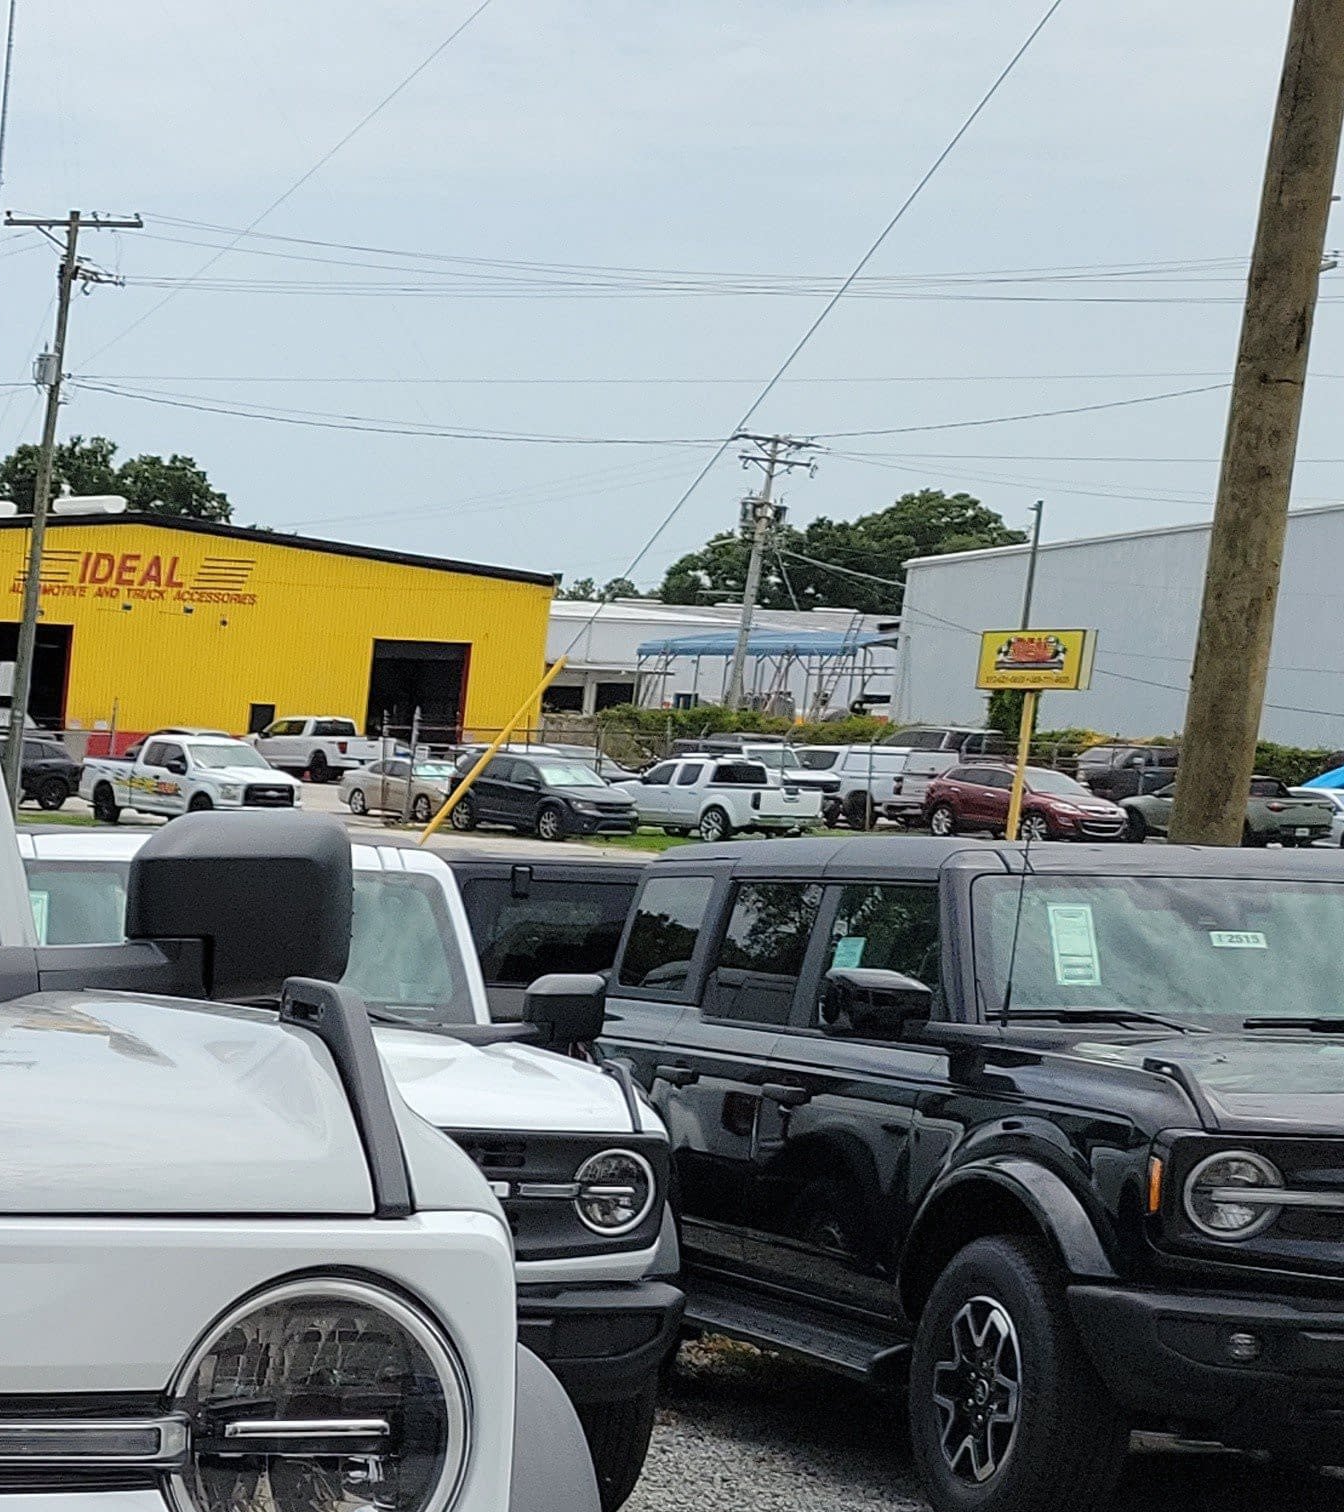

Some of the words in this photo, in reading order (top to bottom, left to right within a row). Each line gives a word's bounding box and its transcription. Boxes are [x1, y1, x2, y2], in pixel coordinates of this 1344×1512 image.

[79, 551, 185, 589] IDEAL
[10, 582, 87, 598] AUMOTIVE
[94, 586, 120, 600] AND
[127, 588, 167, 602] TRUCK
[173, 591, 257, 606] ACCESSORIES
